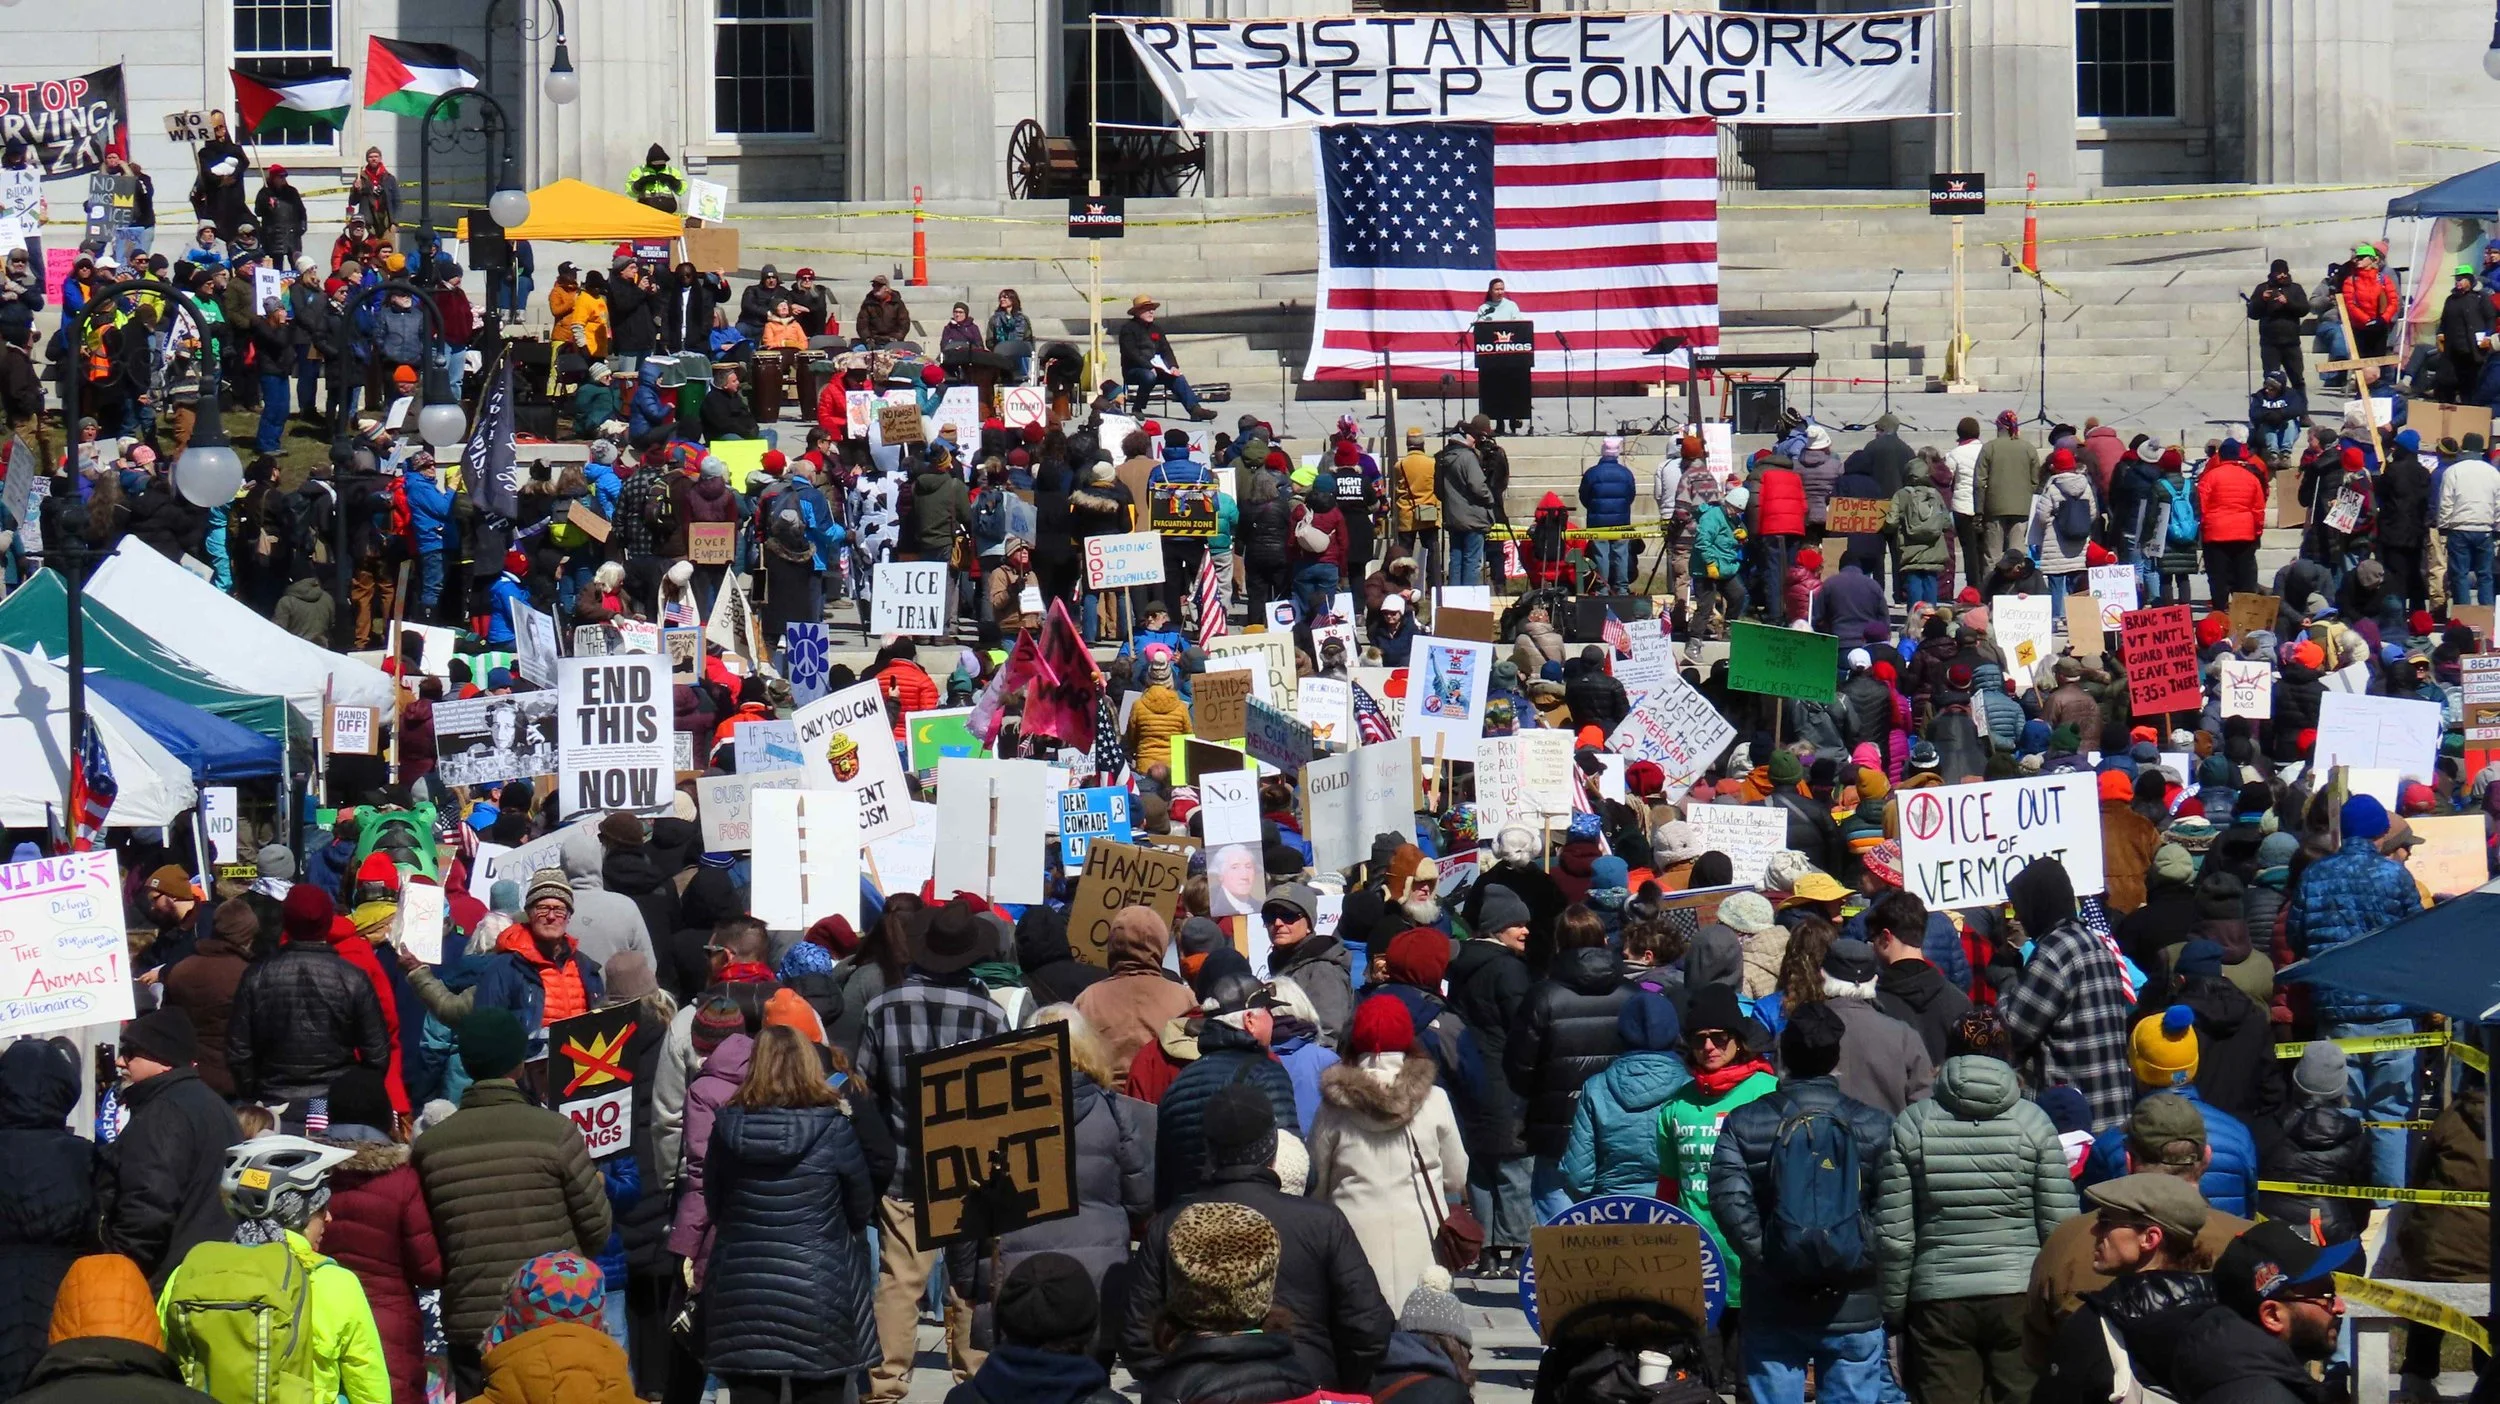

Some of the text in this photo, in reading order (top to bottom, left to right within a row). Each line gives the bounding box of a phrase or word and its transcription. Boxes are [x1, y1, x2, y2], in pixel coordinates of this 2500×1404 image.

[1134, 15, 1922, 73] RESISTANCE WORKS!
[1279, 65, 1765, 118] KEEP GOING!
[175, 114, 201, 126] NO
[169, 128, 209, 142] WAR
[92, 176, 115, 192] NO
[1931, 191, 1984, 200] NO KINGS
[109, 208, 132, 223] ICE
[1070, 215, 1122, 223] NO KINGS
[1476, 343, 1532, 352] NO KINGS
[1337, 477, 1361, 486] FIGHT
[1339, 486, 1361, 494] HATE
[1836, 500, 1876, 511] POWER
[1153, 520, 1213, 528] EVACUATION ZONE
[1832, 516, 1877, 531] PEOPLE
[695, 538, 726, 547] OVER
[694, 549, 731, 559] EMPIRE
[904, 571, 938, 595] ICE
[2091, 567, 2131, 580] NO KINGS
[897, 606, 938, 629] IRAN
[2125, 608, 2183, 630] BRING THE
[2127, 623, 2190, 649] VT NAT'L
[2129, 642, 2195, 665] GUARD HOME
[2130, 658, 2195, 683] LEAVE THE
[2470, 659, 2500, 669] 8647
[582, 665, 651, 705] END
[1194, 674, 1250, 700] HANDS
[2168, 674, 2199, 693] THERE
[2233, 701, 2254, 709] KINGS
[2234, 691, 2254, 701] NO
[337, 709, 367, 721] HANDS
[800, 696, 879, 743] ONLY YOU CAN
[1204, 702, 1241, 723] OFF
[1653, 687, 1715, 751] JUSTICE
[1673, 681, 1729, 740] TRUTH
[337, 720, 367, 733] OFF!
[577, 705, 658, 746] THIS
[1648, 706, 1698, 759] and the
[1633, 709, 1688, 765] AMERICAN
[1641, 735, 1670, 761] WAY
[579, 767, 658, 807] NOW
[1311, 771, 1350, 795] GOLD
[712, 784, 745, 804] OUR
[1063, 793, 1088, 812] DEAR
[1207, 783, 1249, 805] No.
[1502, 787, 1518, 802] US
[1064, 813, 1108, 833] COMRADE
[1481, 808, 1499, 825] NO
[1692, 807, 1704, 823] A
[1949, 786, 2066, 844] ICE OUT
[1071, 837, 1084, 855] 47
[1997, 835, 2018, 853] OF
[1086, 846, 1181, 893] HANDS
[11, 942, 41, 963] THE
[24, 953, 119, 997] ANIMALS!
[6, 995, 89, 1020] Billionaires
[921, 1049, 1052, 1127] ICE
[571, 1101, 620, 1132] NO
[1561, 1233, 1679, 1249] IMAGINE BEING
[1539, 1255, 1687, 1281] AFRAID
